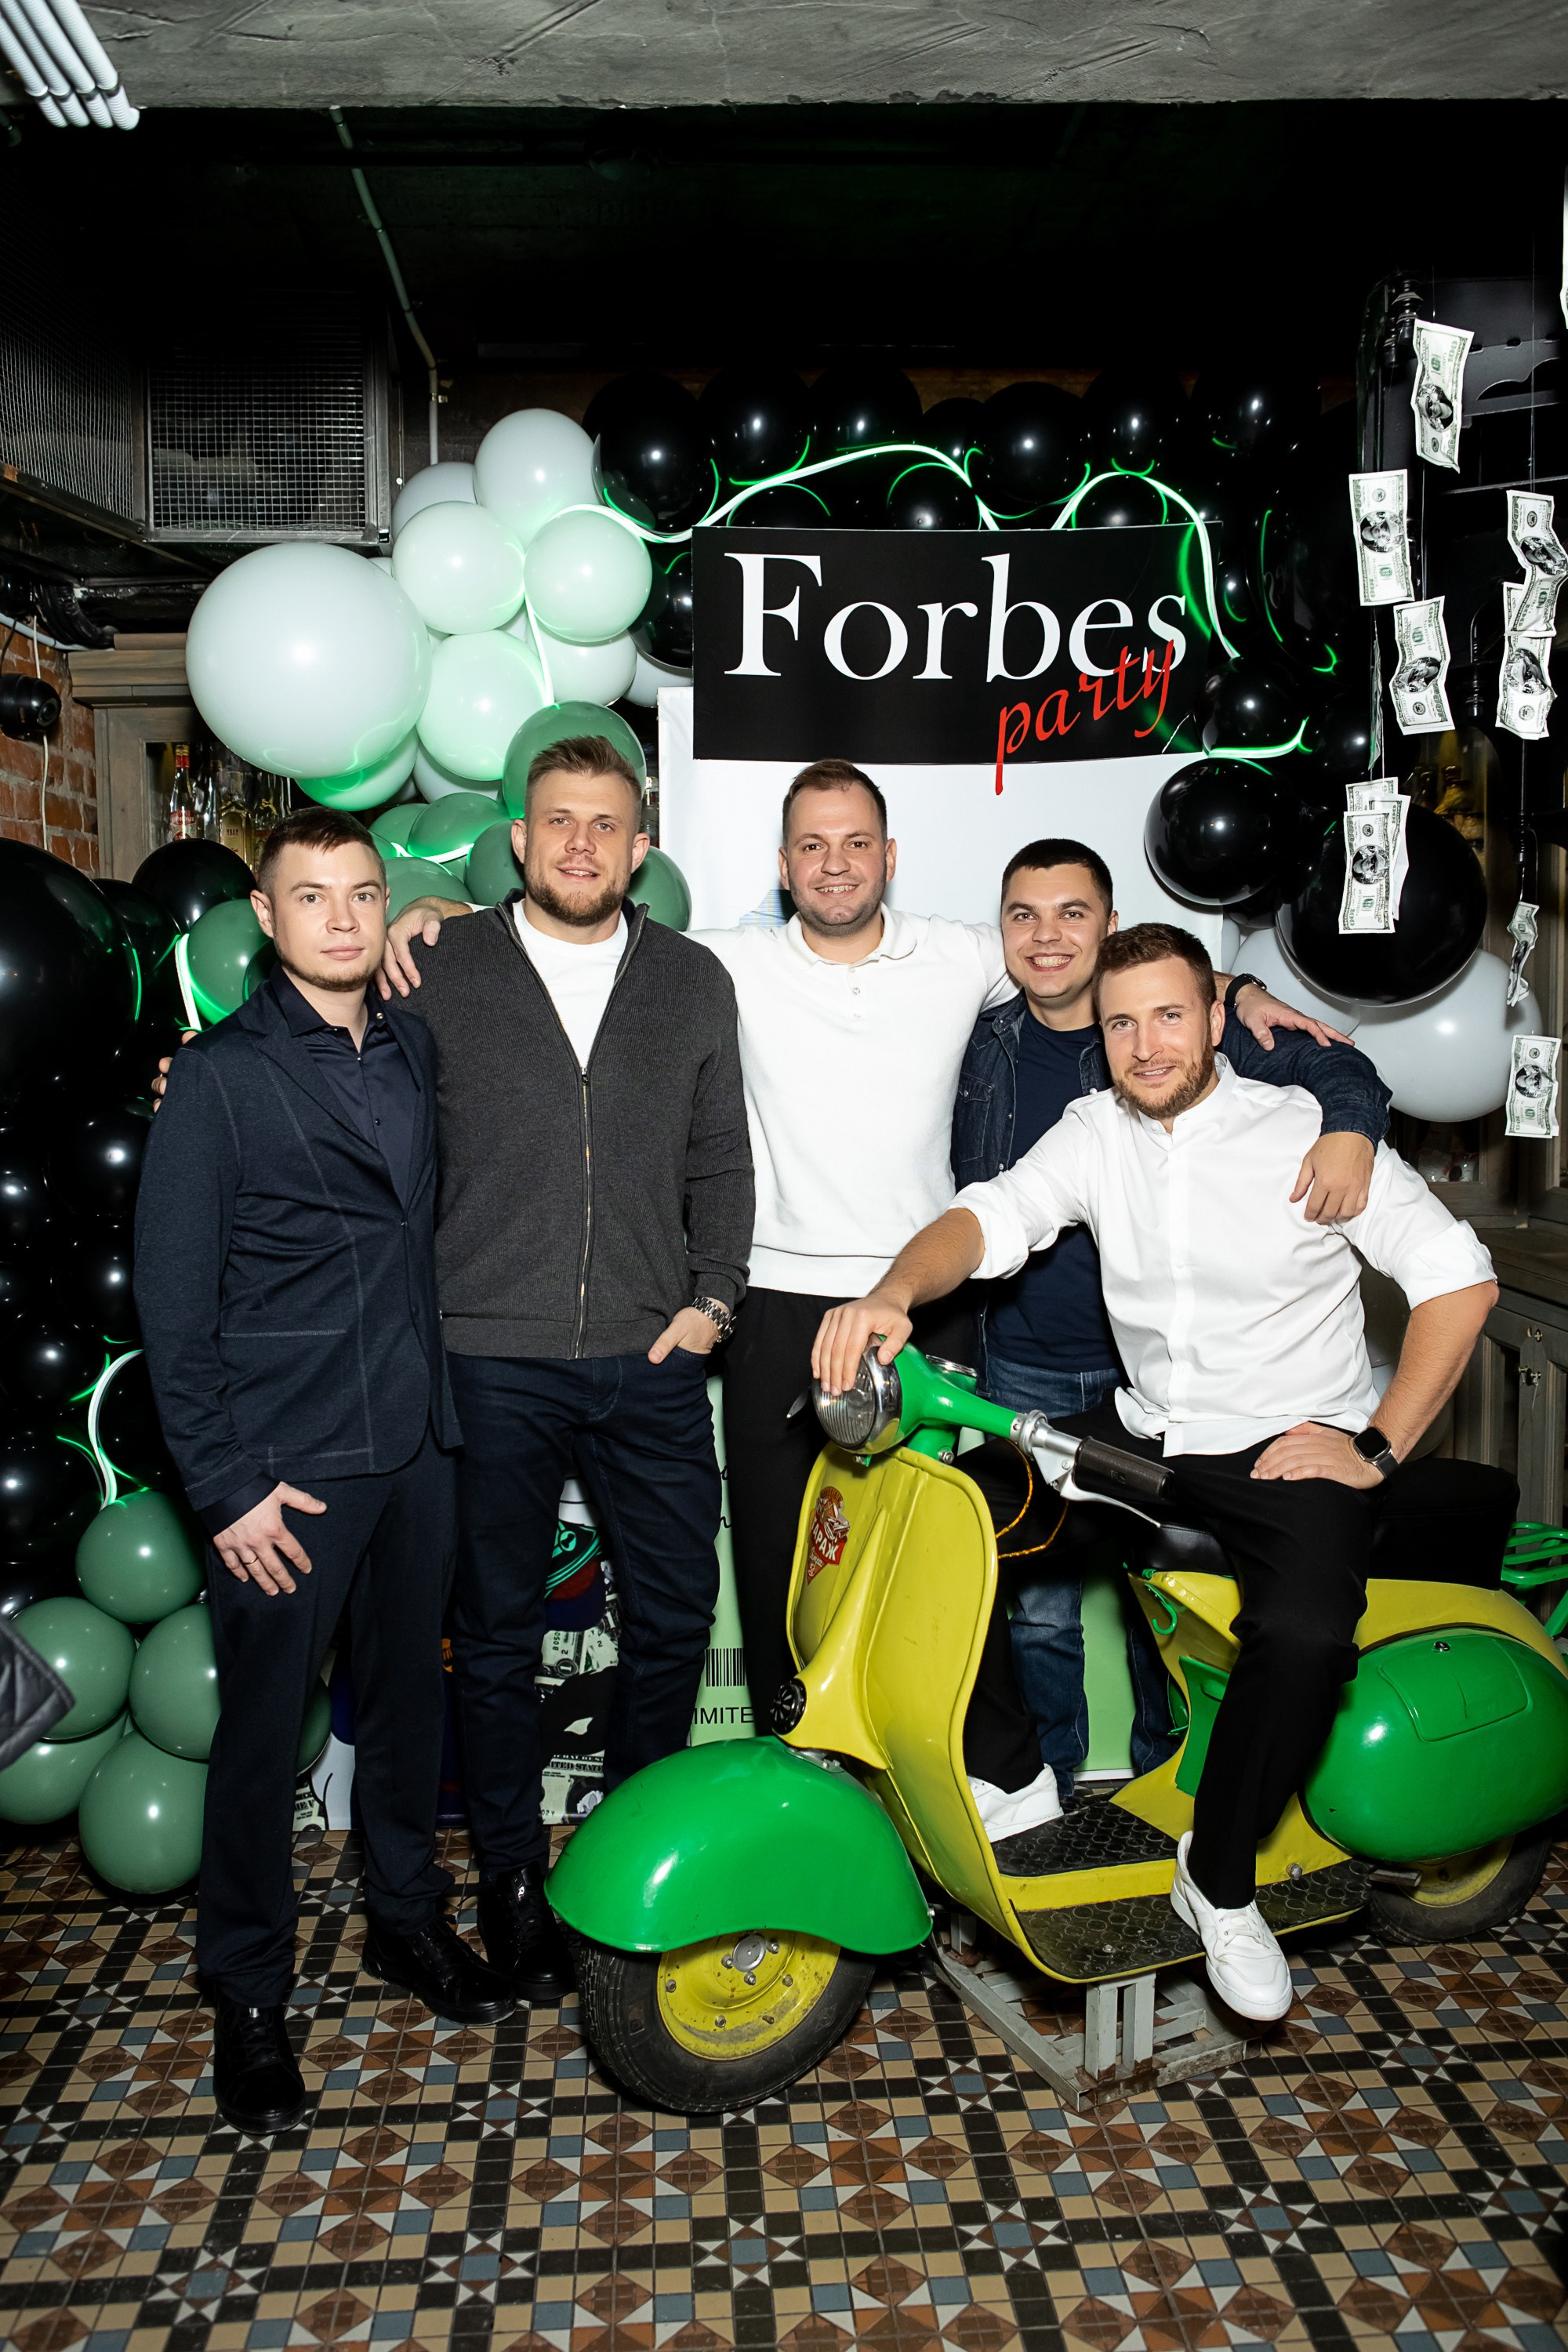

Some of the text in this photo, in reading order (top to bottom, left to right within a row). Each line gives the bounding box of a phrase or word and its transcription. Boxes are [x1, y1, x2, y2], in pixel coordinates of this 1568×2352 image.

[724, 552, 1187, 683] Forbes
[995, 638, 1174, 795] party
[811, 1516, 840, 1561] ГАРАЖ
[694, 1706, 754, 1725] IMITE
[550, 1761, 603, 1773] ITED STATE
